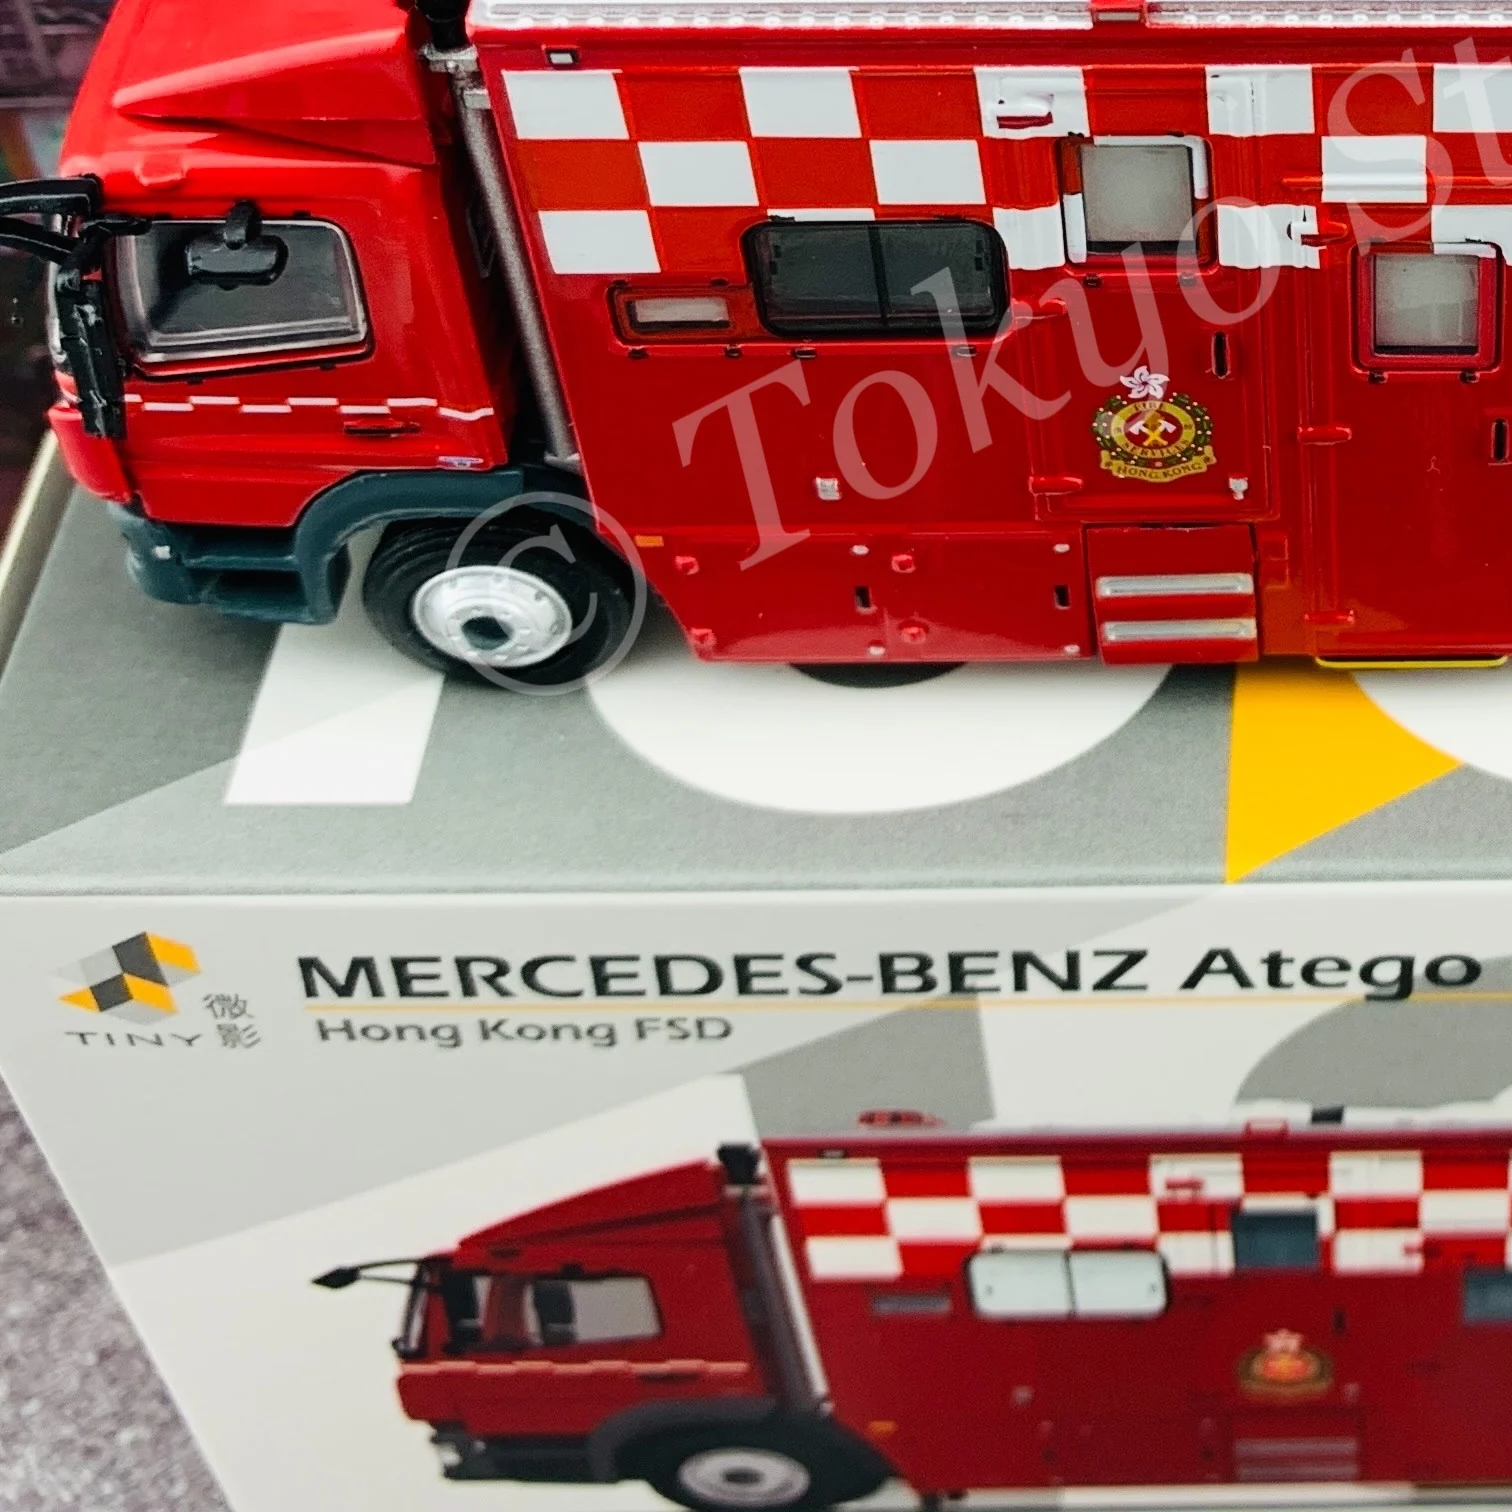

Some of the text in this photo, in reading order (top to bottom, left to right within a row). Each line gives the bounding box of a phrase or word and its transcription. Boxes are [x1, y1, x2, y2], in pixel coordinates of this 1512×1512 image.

[1117, 462, 1202, 480] HONG KONG
[298, 949, 1148, 998] MERCEDES-BENZ
[1180, 948, 1482, 1002] Atego
[65, 1031, 203, 1047] TINY
[316, 1017, 734, 1049] Hong Kong FSD
